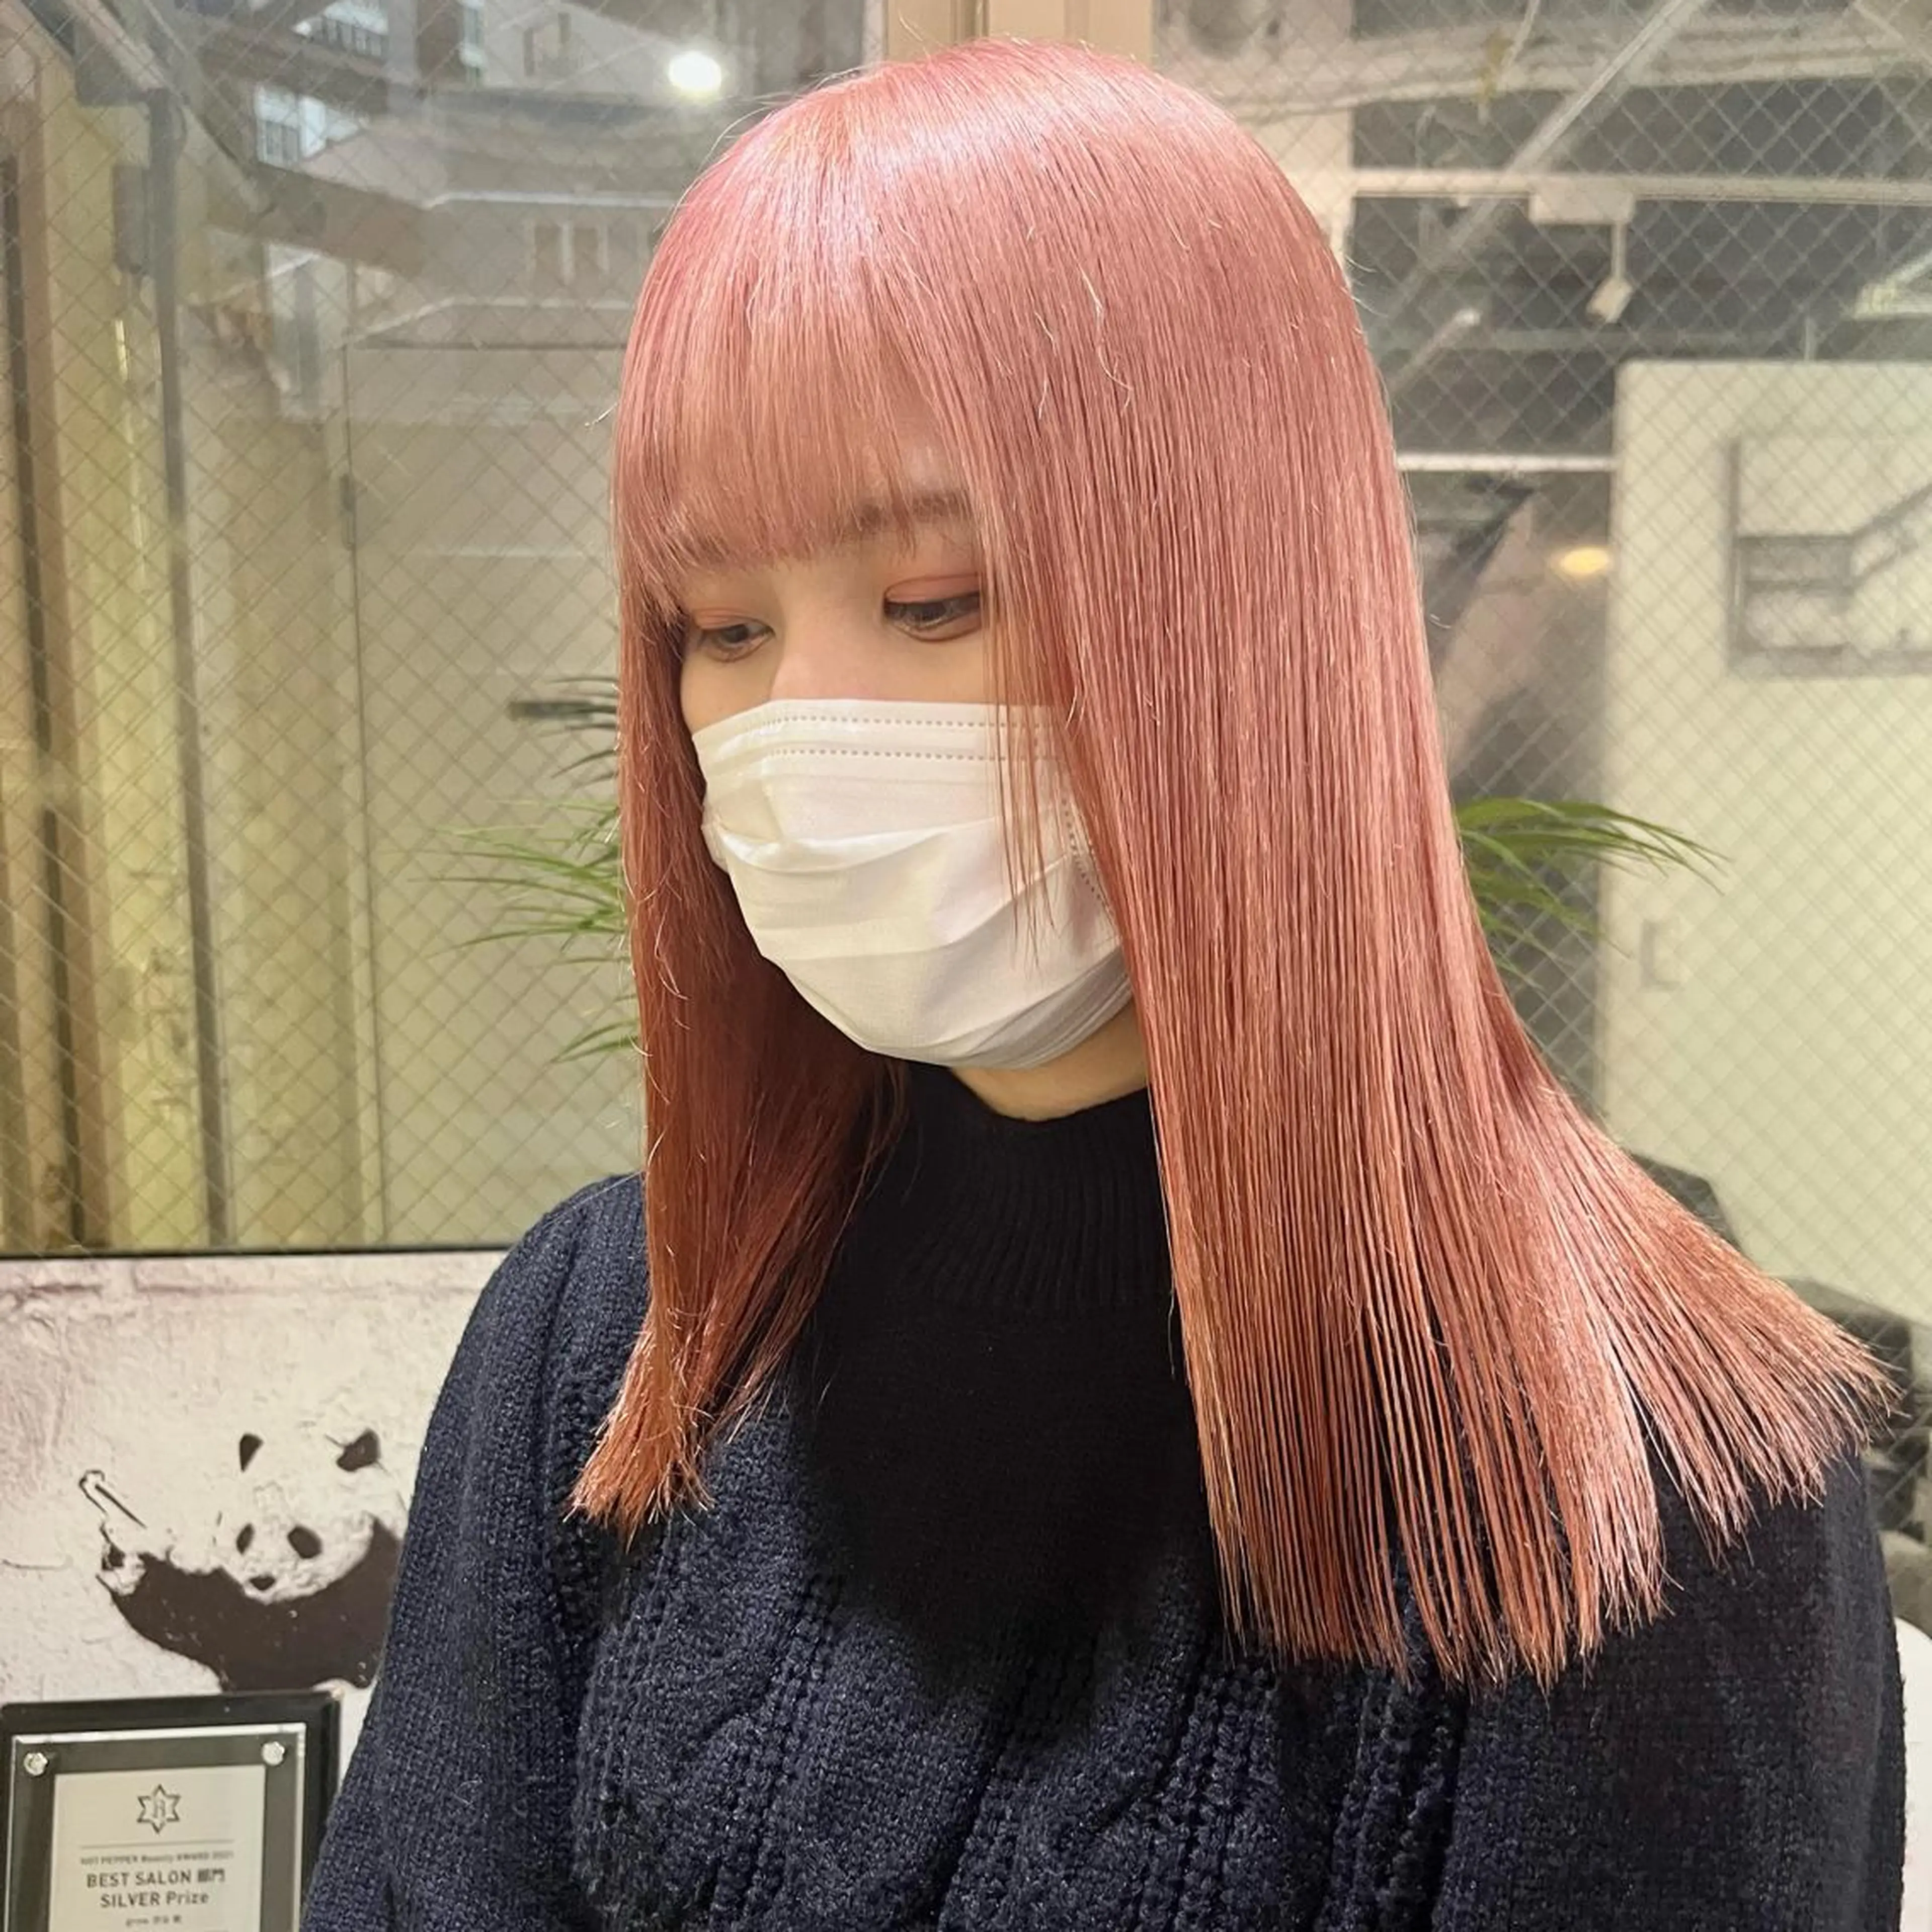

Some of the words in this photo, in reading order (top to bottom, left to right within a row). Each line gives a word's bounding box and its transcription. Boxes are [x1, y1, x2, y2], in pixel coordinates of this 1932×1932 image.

[87, 1872, 129, 1888] BEST
[135, 1869, 192, 1886] SALON
[100, 1891, 160, 1908] SILVER
[166, 1889, 209, 1905] Prize
